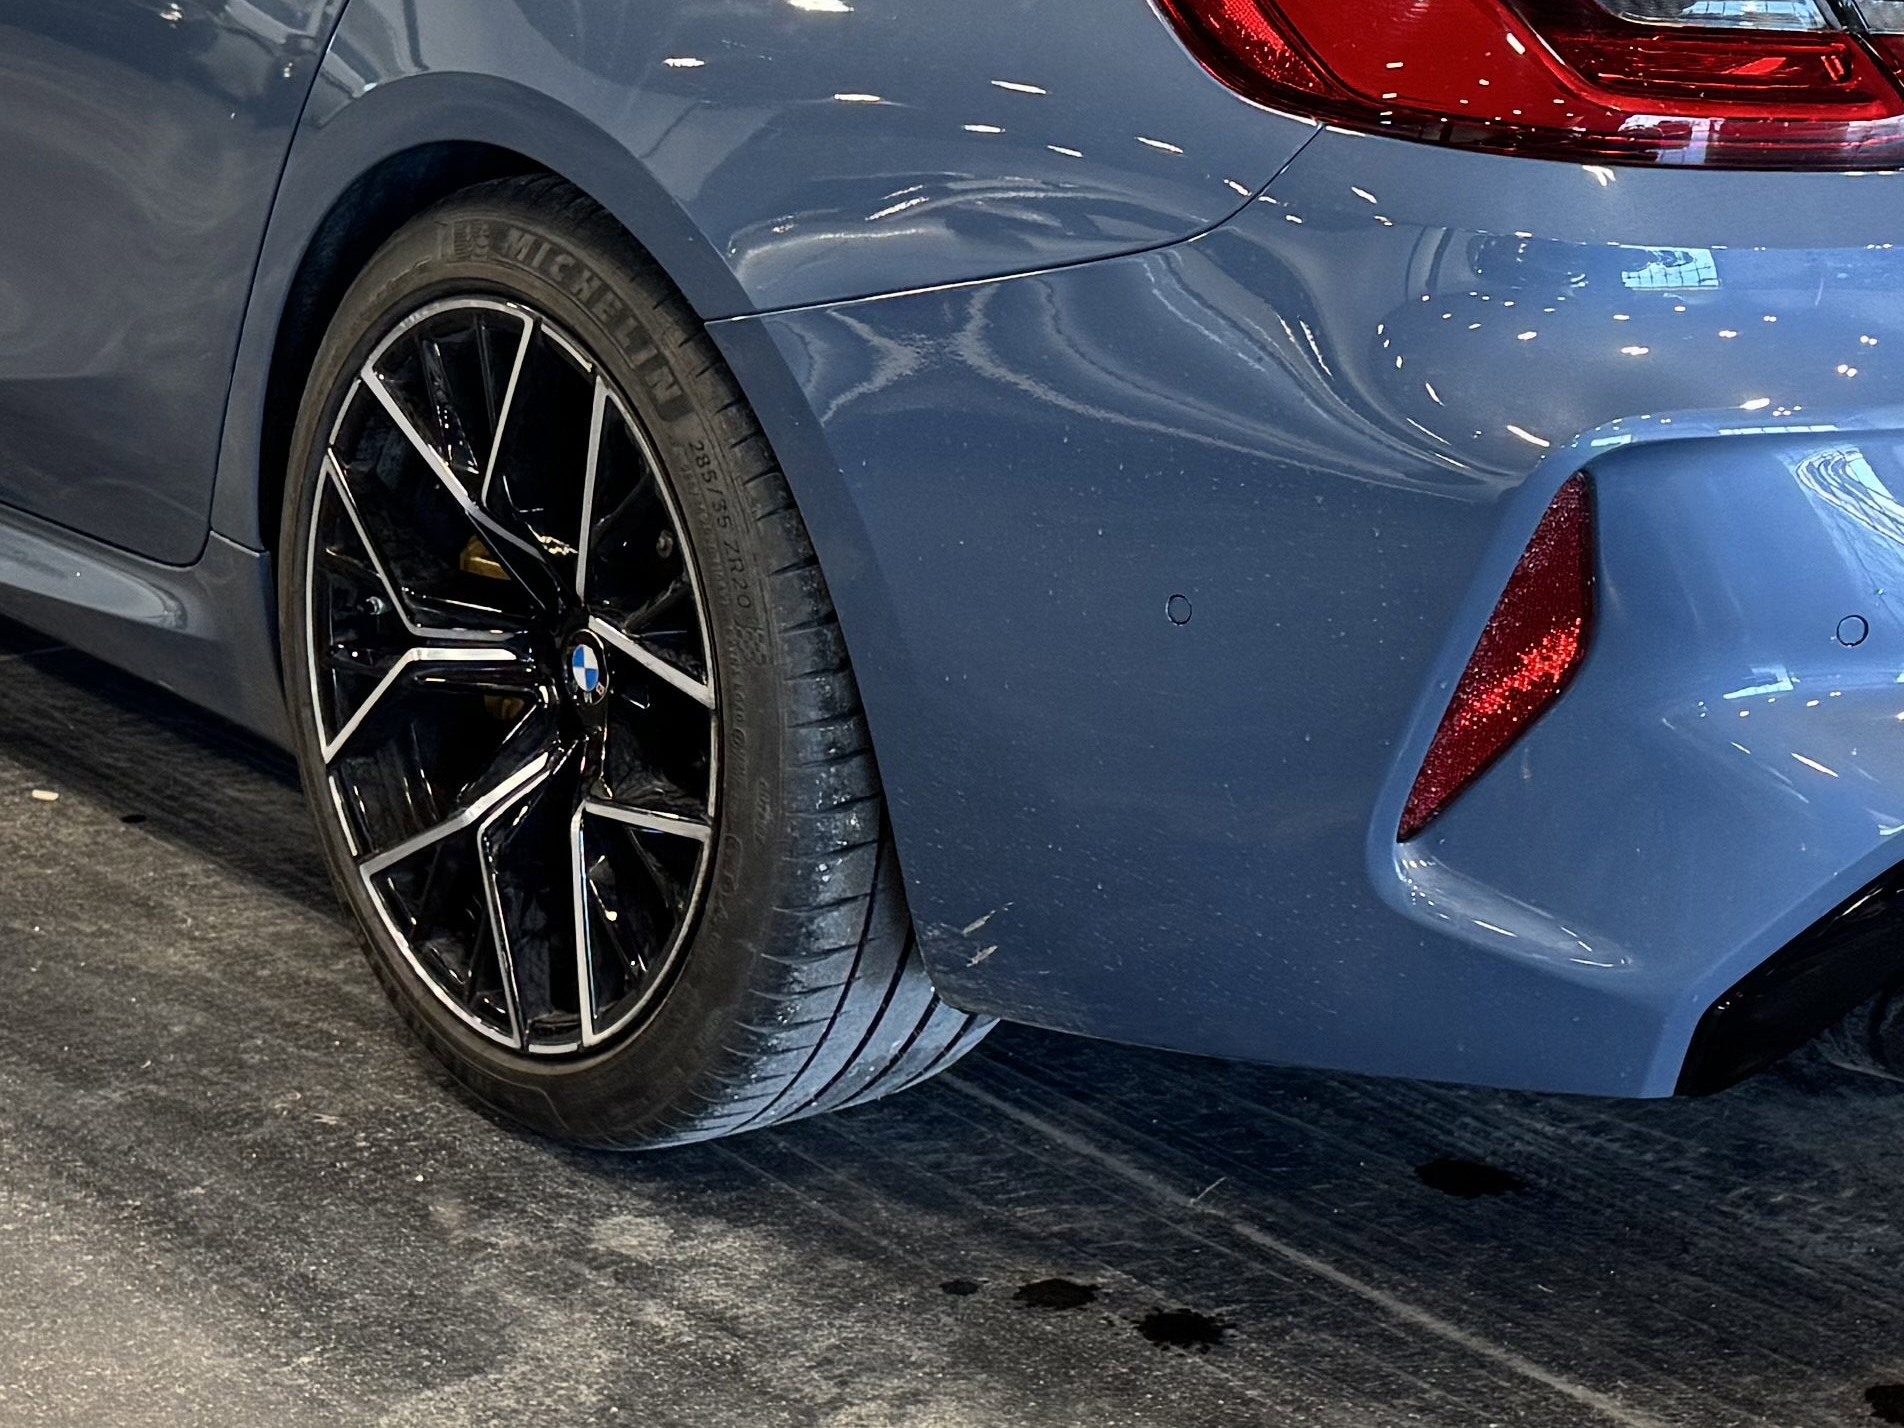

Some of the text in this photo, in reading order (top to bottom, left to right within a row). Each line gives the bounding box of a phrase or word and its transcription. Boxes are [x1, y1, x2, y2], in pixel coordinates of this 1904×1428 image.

[502, 226, 683, 405] MICHELIN
[689, 439, 732, 529] 285/35
[724, 540, 752, 610] ZR20
